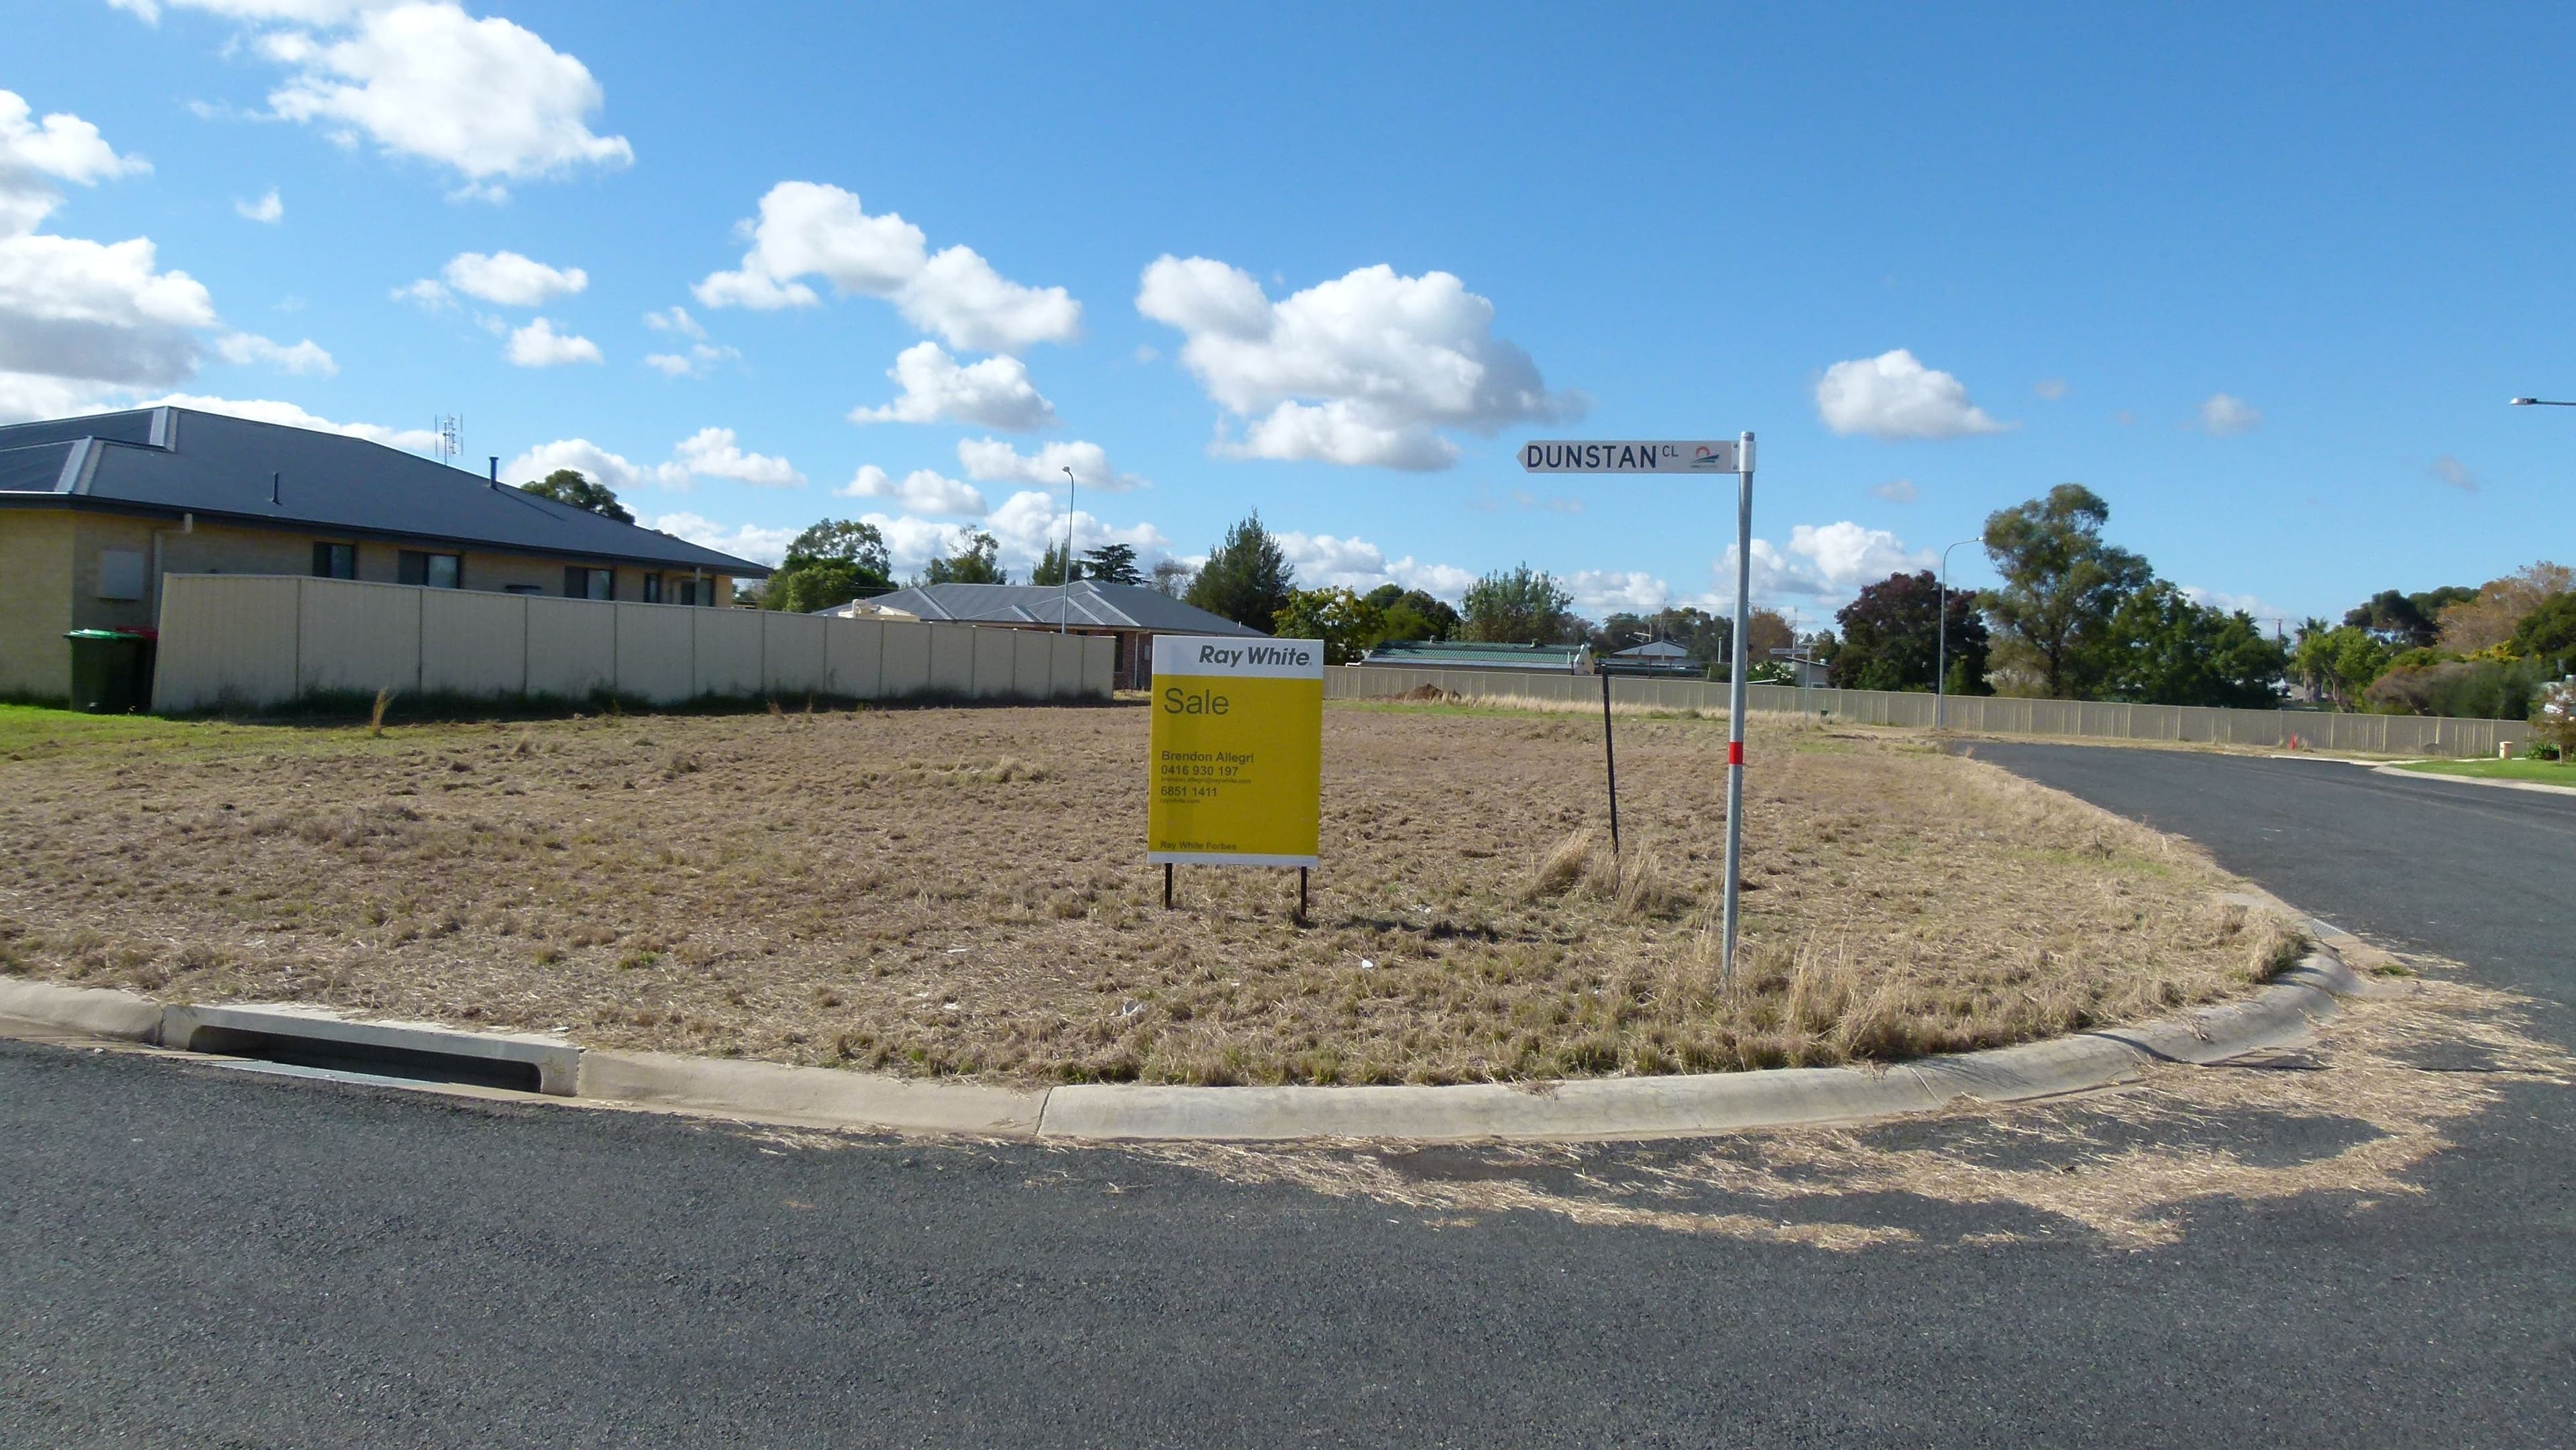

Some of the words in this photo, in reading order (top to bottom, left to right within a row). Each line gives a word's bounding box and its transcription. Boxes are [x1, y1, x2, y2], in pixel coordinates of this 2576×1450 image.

[1527, 445, 1657, 468] DUNSTAN
[1662, 445, 1679, 457] CL
[1199, 645, 1244, 667] Ray
[1248, 647, 1310, 666] White
[1164, 687, 1230, 716] Sale
[1161, 750, 1213, 762] Brendon
[1216, 751, 1254, 765] Allegri
[1161, 764, 1189, 775] 0416
[1192, 765, 1214, 776] 930
[1218, 766, 1239, 777] 197
[1160, 785, 1187, 796] 6851
[1192, 787, 1218, 797] 1411
[1159, 840, 1177, 850] Ray
[1179, 841, 1204, 850] White
[1205, 842, 1237, 850] Forbes
